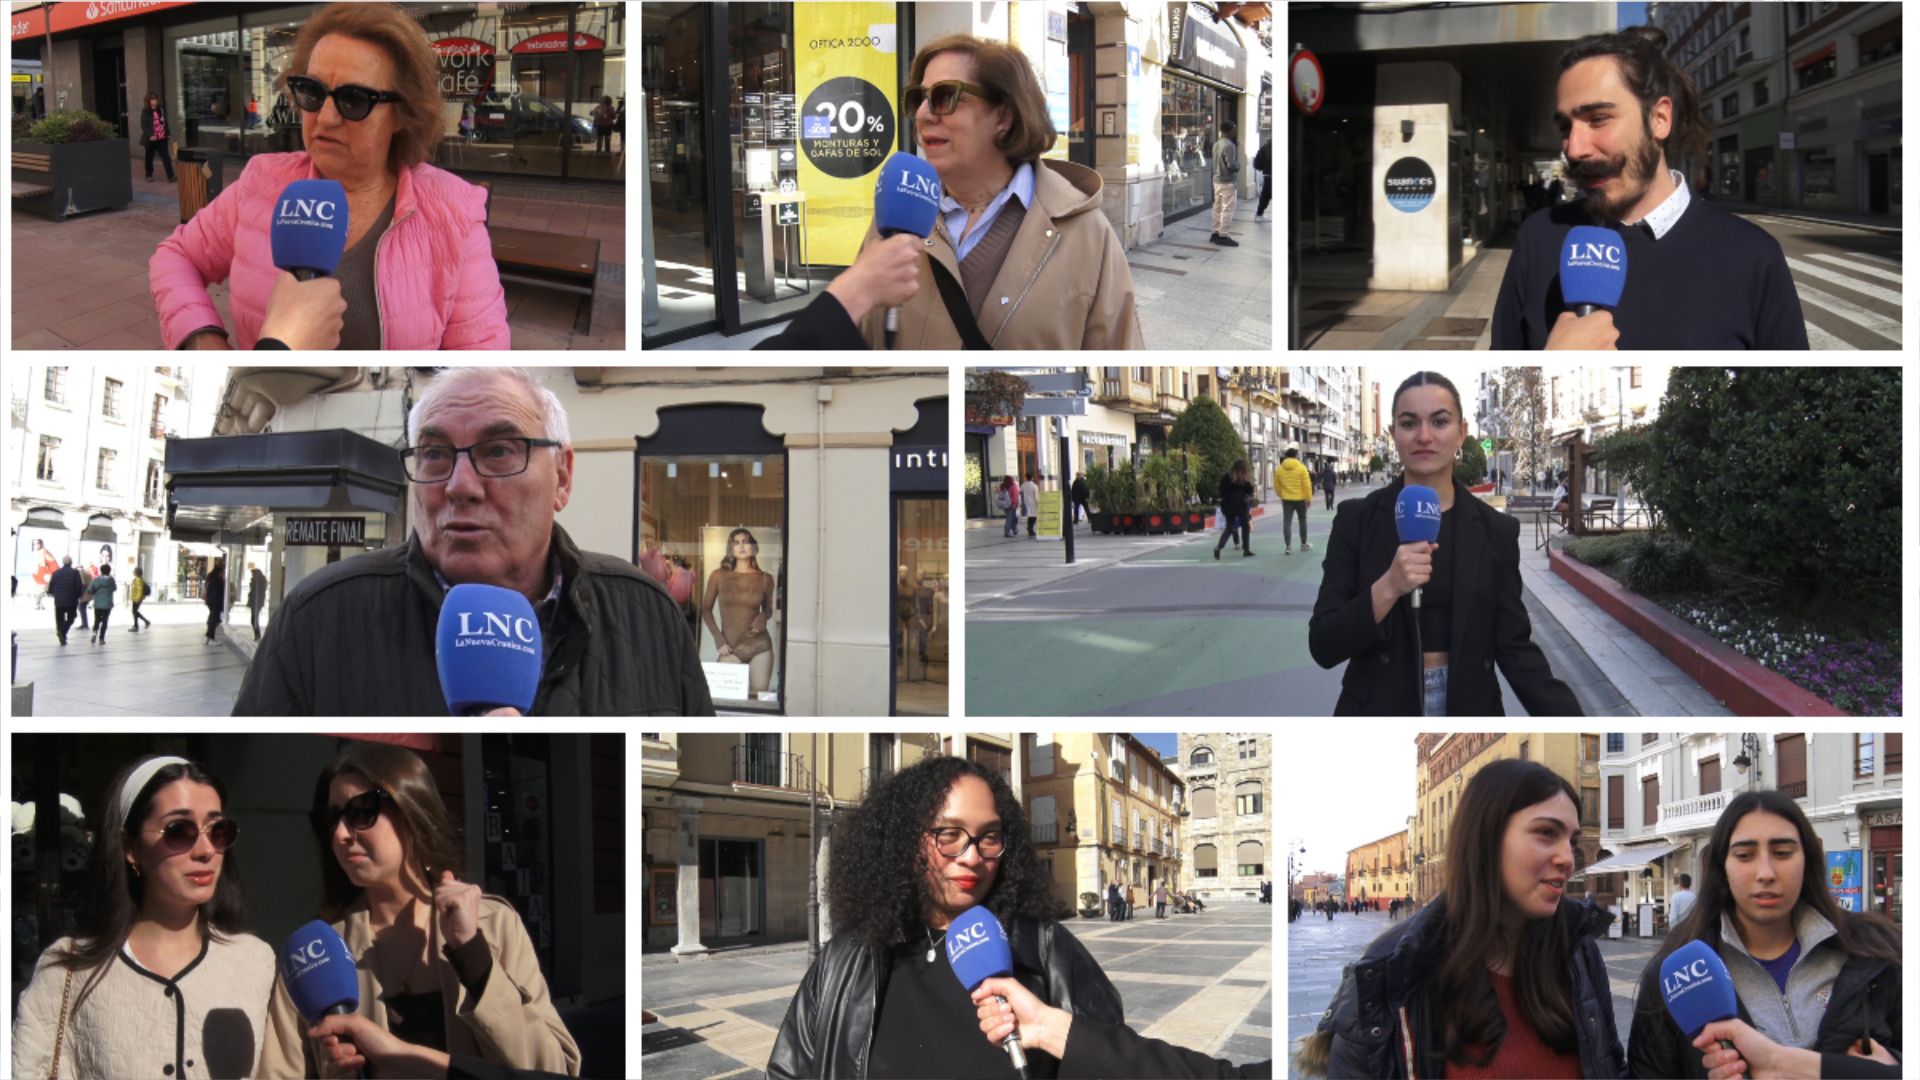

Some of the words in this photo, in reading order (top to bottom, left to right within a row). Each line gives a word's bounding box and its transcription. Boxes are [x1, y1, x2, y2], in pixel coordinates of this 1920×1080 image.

[847, 36, 881, 47] 2000
[816, 100, 884, 133] 20%
[810, 148, 844, 158] GAFAS
[846, 148, 860, 158] DE
[862, 147, 883, 157] SOL
[813, 138, 869, 149] MONTURAS
[873, 138, 880, 147] Y
[900, 169, 940, 200] LNC
[280, 199, 336, 221] LNC
[1569, 243, 1621, 263] LNC
[895, 449, 948, 468] inti
[287, 520, 328, 543] REMATE
[330, 521, 364, 543] FINAL
[458, 611, 535, 643] LNC
[948, 921, 987, 958] LNC
[283, 938, 326, 980] LNC
[1663, 957, 1709, 997] LNC
